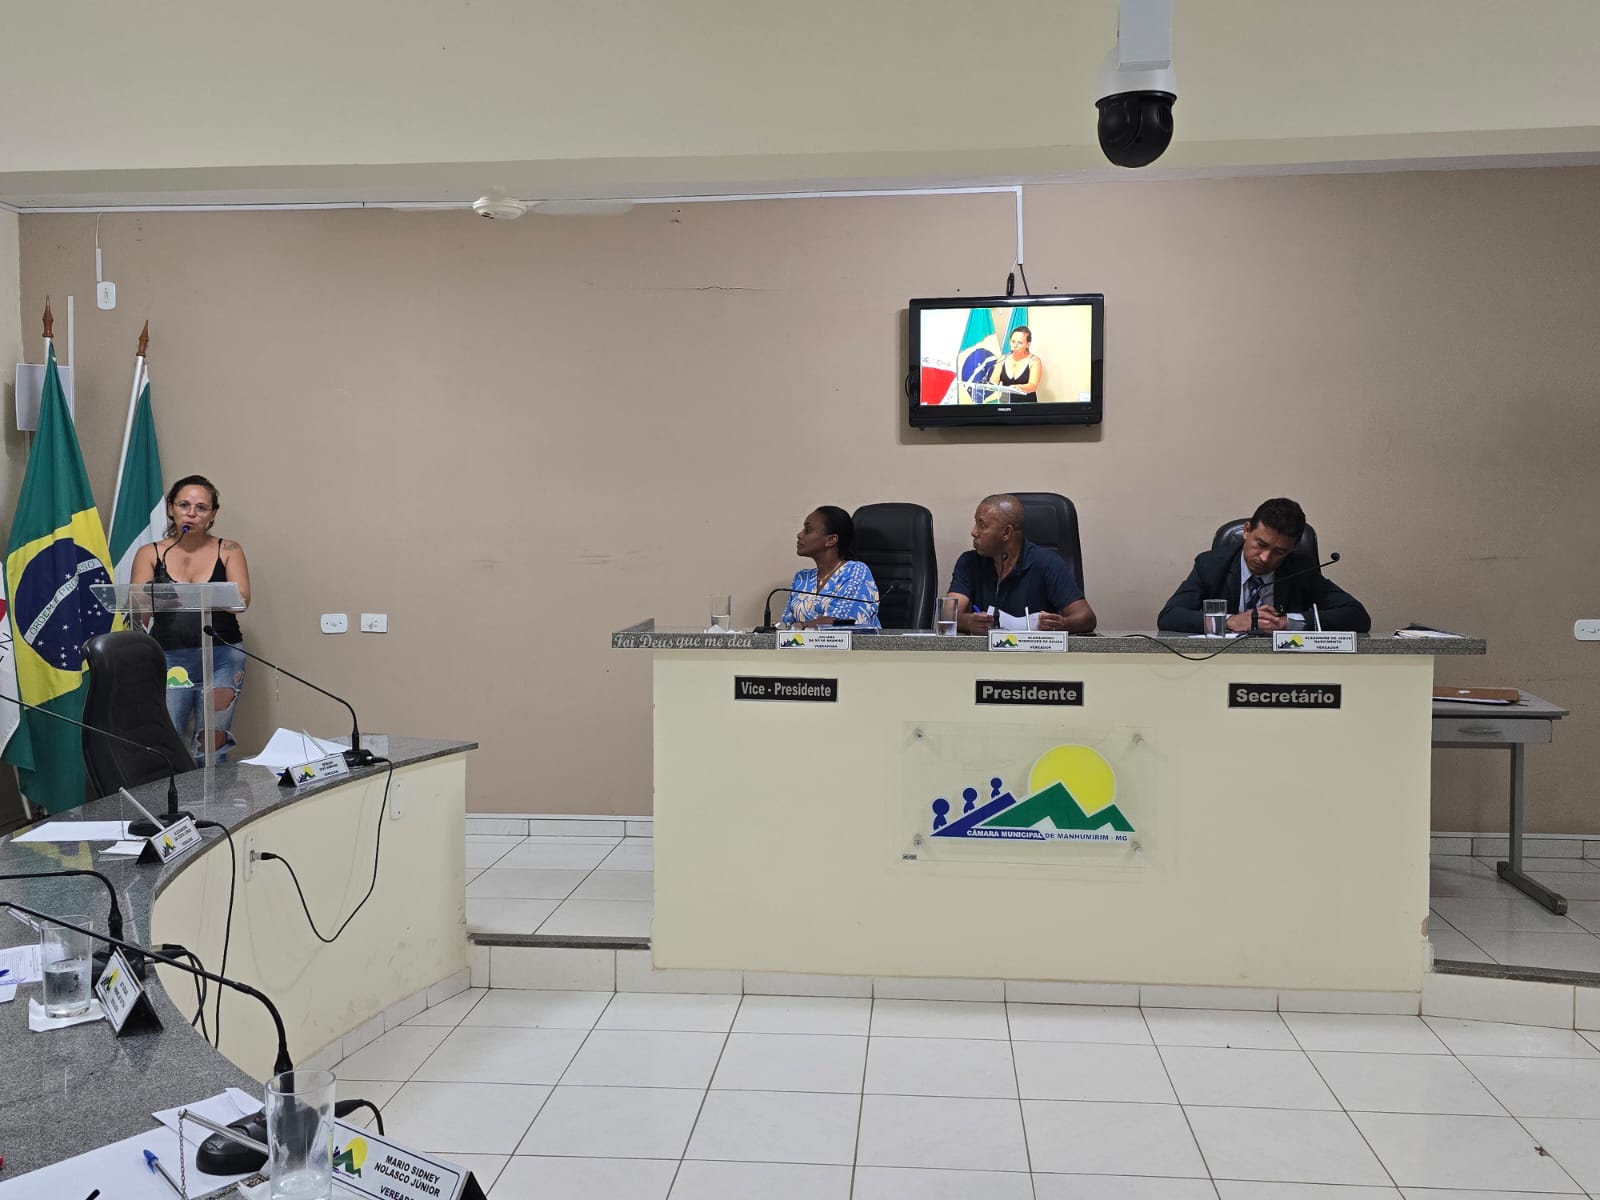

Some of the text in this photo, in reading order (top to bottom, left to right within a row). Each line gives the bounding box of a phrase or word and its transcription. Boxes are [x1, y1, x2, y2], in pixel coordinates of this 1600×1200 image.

[29, 604, 55, 635] ORDEM
[639, 633, 675, 648] Deus
[675, 636, 701, 649] que
[703, 637, 724, 647] me
[727, 635, 752, 648] deu
[741, 681, 765, 695] Vice
[774, 682, 831, 697] Presidente
[982, 685, 1077, 700] Presidente
[1236, 688, 1335, 703] Secretário
[966, 829, 999, 837] CÂMARA
[1001, 830, 1042, 839] MUNICIPAL
[1057, 833, 1109, 841] MANHUMIRIM
[385, 1154, 440, 1184] MARIO SIDNEY
[374, 1162, 410, 1183] NOLASCO
[410, 1179, 440, 1198] JÚNIOR
[380, 1185, 414, 1200] VEREAD
